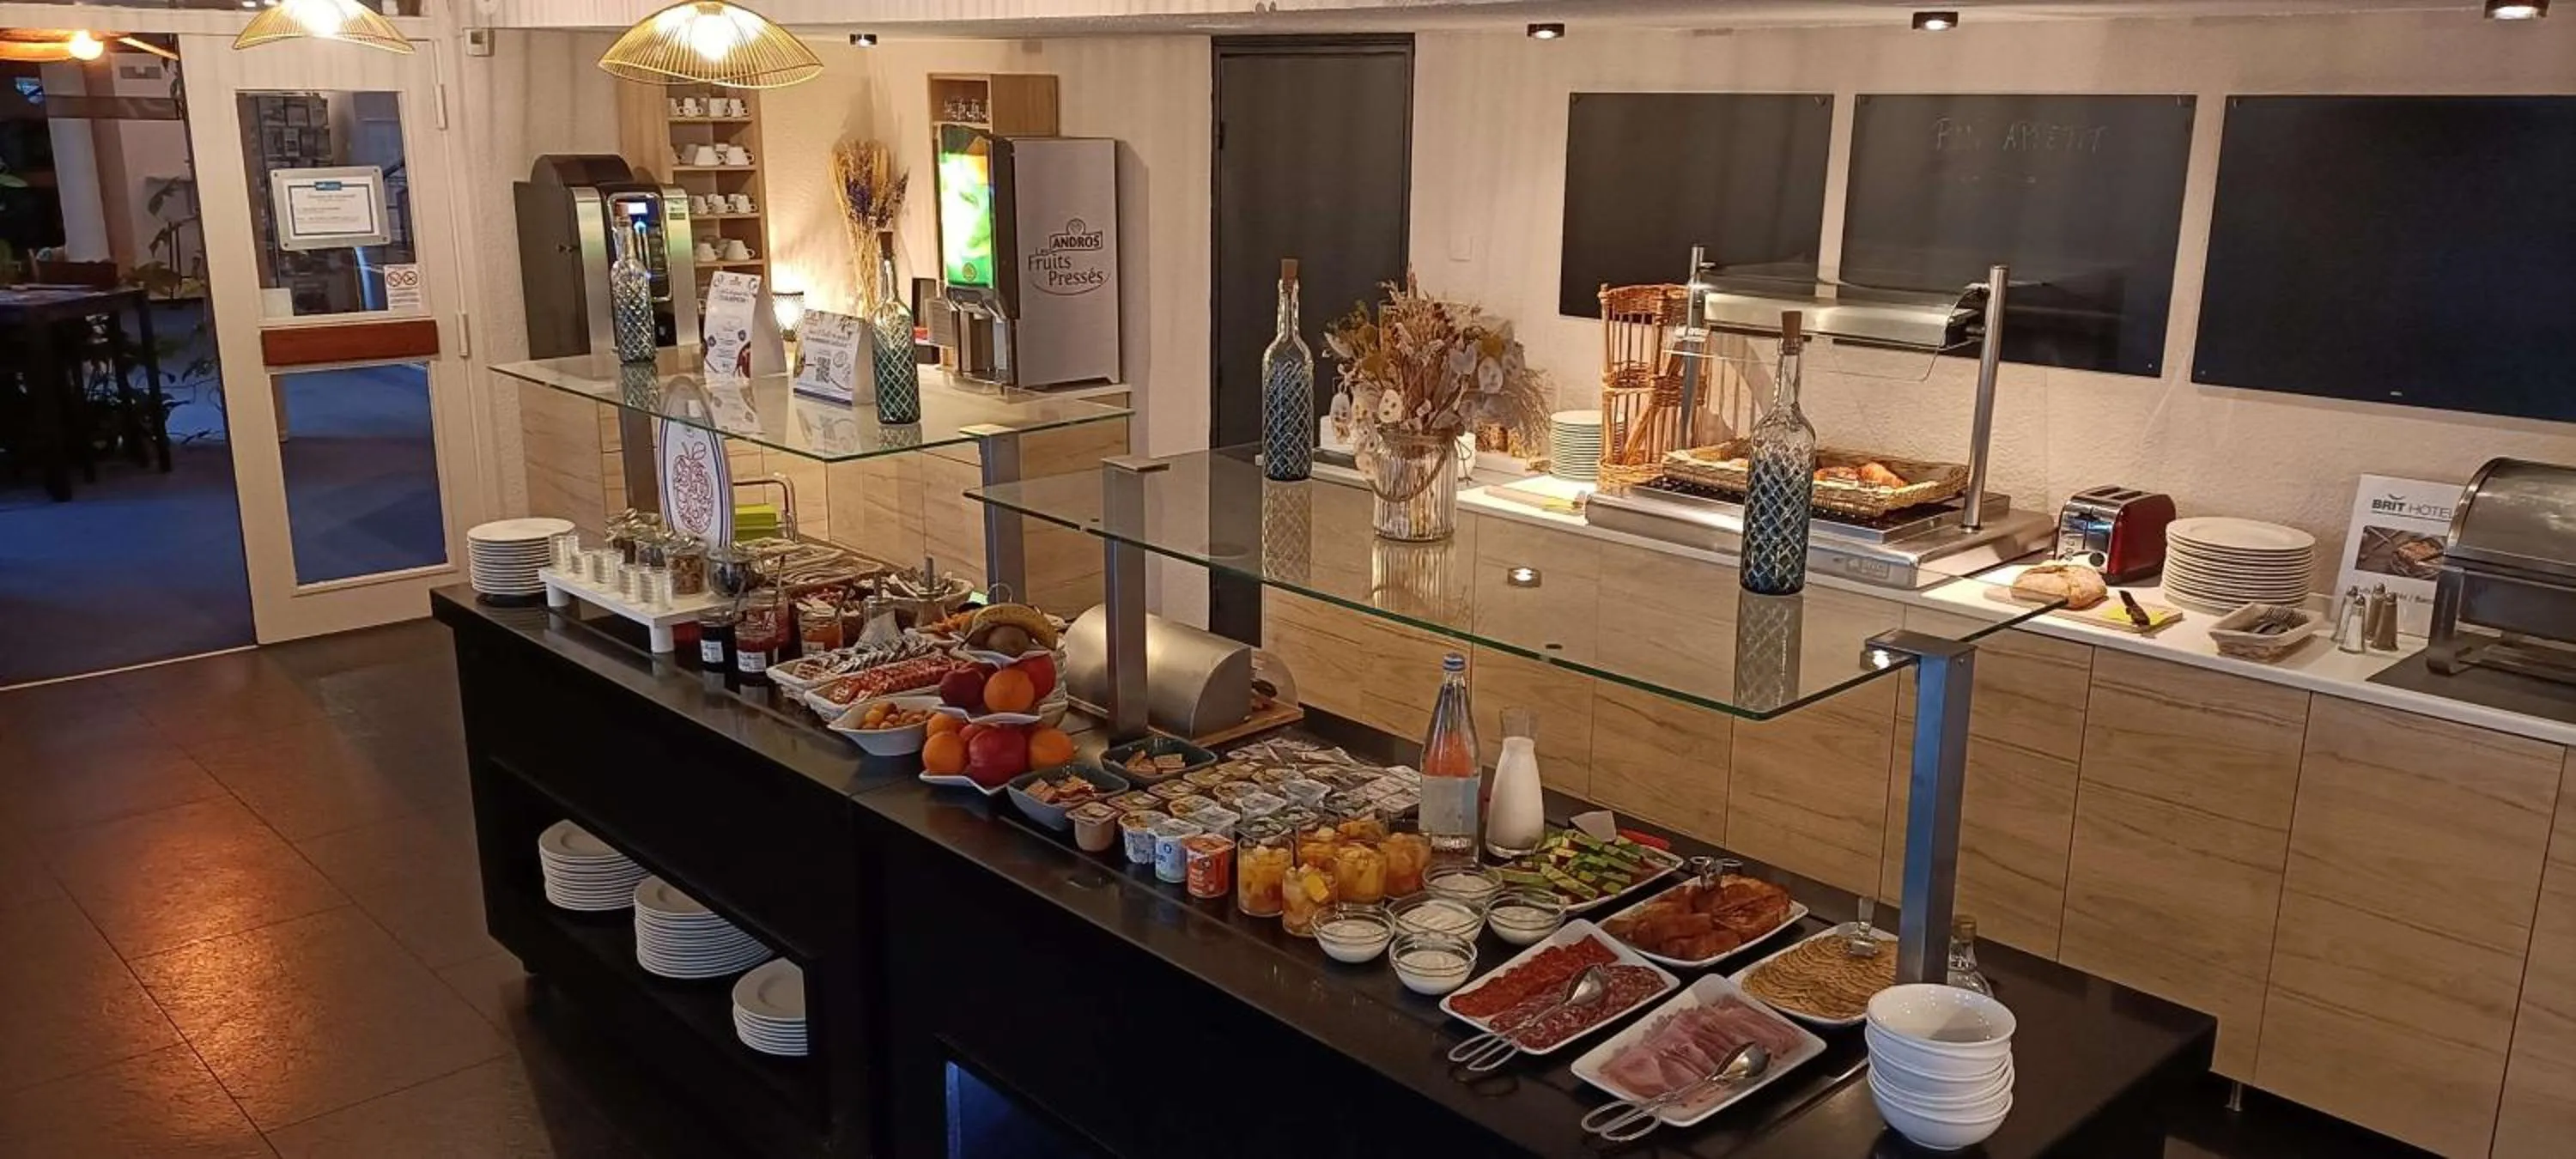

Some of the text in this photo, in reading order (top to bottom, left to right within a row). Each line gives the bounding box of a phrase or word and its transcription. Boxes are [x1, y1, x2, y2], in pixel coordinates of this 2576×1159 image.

[1053, 235, 1100, 248] ANDROS
[1029, 253, 1072, 271] Fruits
[1048, 267, 1103, 286] Pressés
[2372, 499, 2406, 513] BRIT
